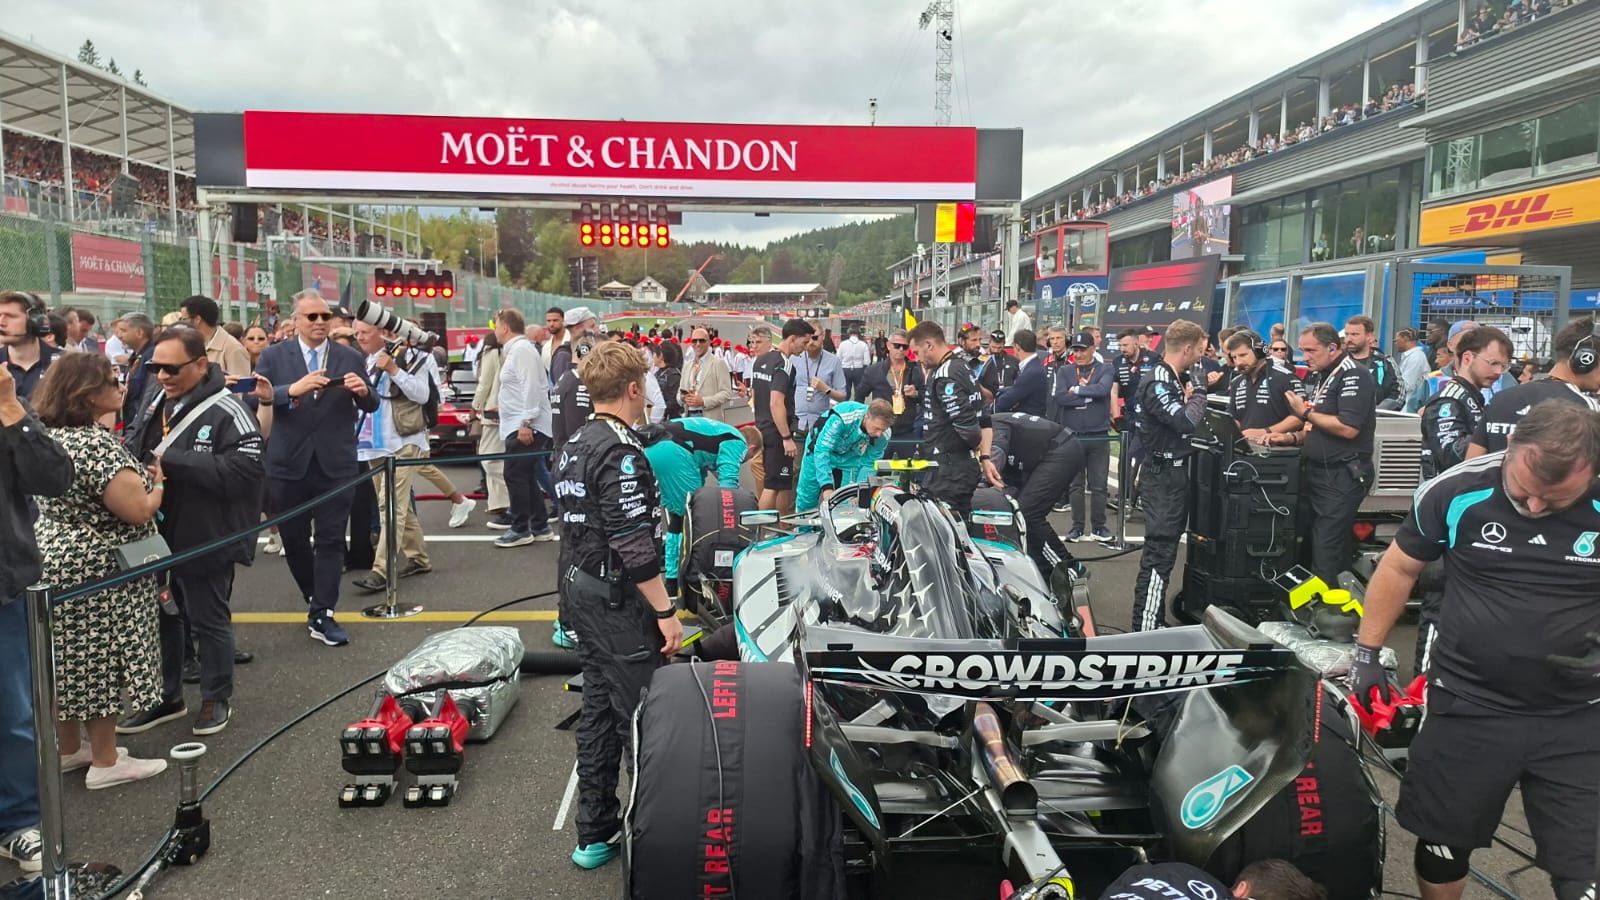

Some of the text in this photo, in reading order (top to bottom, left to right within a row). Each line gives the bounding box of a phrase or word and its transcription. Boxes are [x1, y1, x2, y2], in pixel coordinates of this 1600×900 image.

[440, 126, 798, 171] MOËT & CHANDON
[1464, 193, 1555, 233] DHL
[724, 508, 735, 529] LEFT
[889, 654, 1243, 690] CROWDSTRIKE
[713, 680, 737, 718] LEFT
[1295, 777, 1323, 835] REAR
[704, 808, 733, 873] REAR
